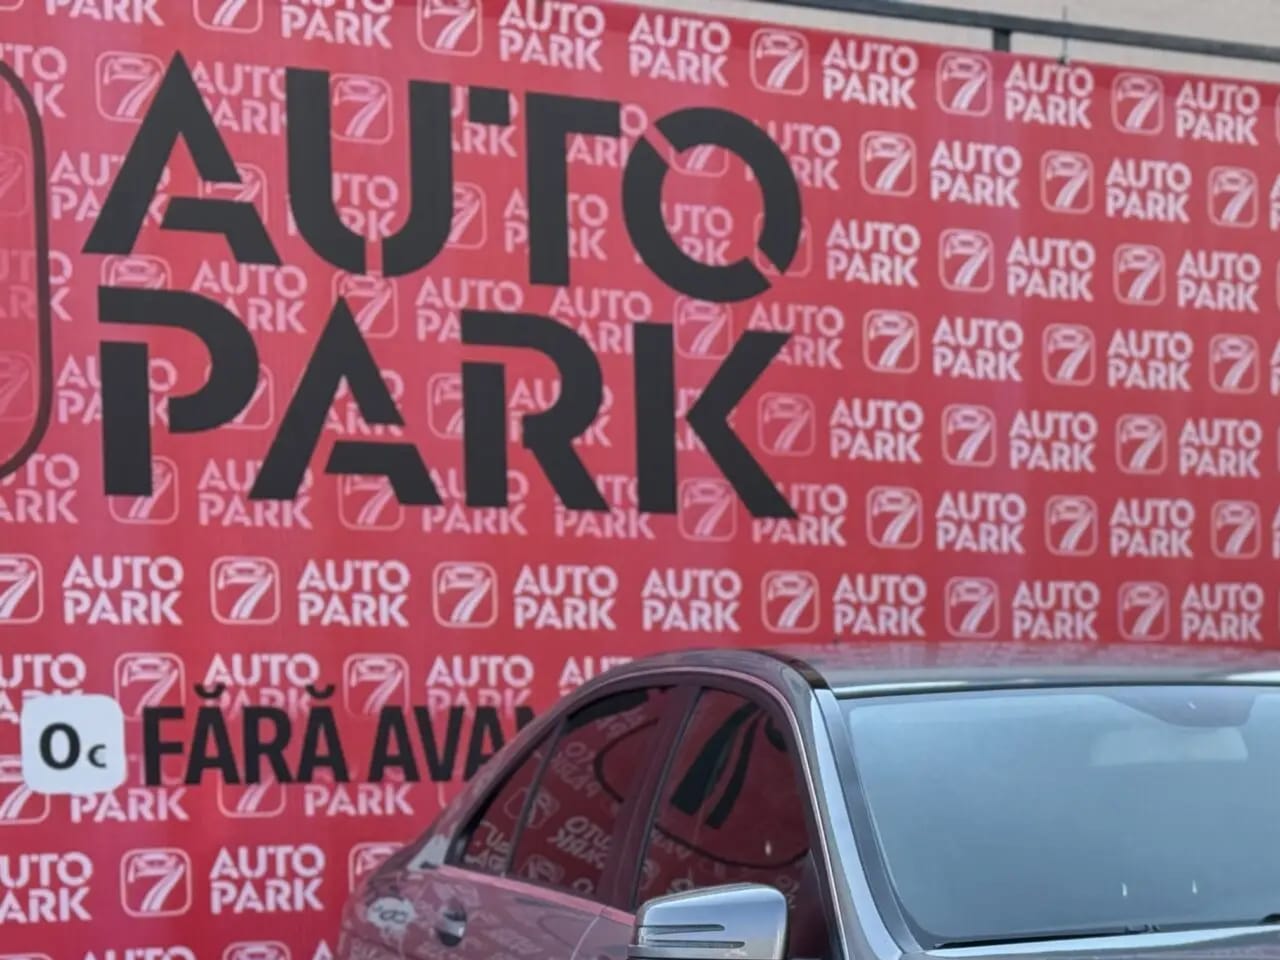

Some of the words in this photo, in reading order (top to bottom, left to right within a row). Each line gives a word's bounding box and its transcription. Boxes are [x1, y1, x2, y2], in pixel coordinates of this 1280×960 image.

[281, 4, 392, 49] PARK
[499, 0, 605, 39] AUTO
[629, 13, 731, 52] AUTO
[499, 30, 603, 72] PARK
[629, 44, 729, 88] PARK
[823, 39, 919, 77] AUTO
[823, 68, 917, 110] PARK
[1005, 62, 1094, 97] AUTO
[1004, 90, 1092, 128] PARK
[1175, 81, 1261, 116] AUTO
[1176, 105, 1259, 146] PARK
[929, 141, 1023, 177] AUTO
[82, 50, 803, 303] AUTO
[930, 168, 1022, 208] PARK
[1105, 160, 1192, 193] AUTO
[1105, 188, 1191, 222] PARK
[827, 220, 921, 255] AUTO
[827, 249, 920, 286] PARK
[1007, 238, 1096, 272] AUTO
[1177, 251, 1261, 283] AUTO
[191, 260, 308, 298] AUTO
[415, 276, 525, 313] AUTO
[1006, 266, 1094, 299] PARK
[1177, 276, 1261, 310] PARK
[549, 286, 653, 322] AUTO
[747, 302, 844, 336] AUTO
[933, 318, 1025, 351] AUTO
[1108, 331, 1194, 360] AUTO
[932, 345, 1023, 380] PARK
[1107, 359, 1192, 389] PARK
[97, 285, 799, 519] PARK
[831, 400, 924, 432] AUTO
[1008, 411, 1099, 442] AUTO
[1178, 419, 1263, 447] AUTO
[831, 428, 923, 462] PARK
[1009, 439, 1096, 470] PARK
[1178, 446, 1261, 476] PARK
[199, 493, 312, 530] PARK
[936, 492, 1028, 522] AUTO
[1110, 499, 1196, 529] AUTO
[936, 521, 1026, 552] PARK
[1109, 528, 1194, 556] PARK
[63, 556, 183, 591] AUTO
[298, 560, 410, 593] AUTO
[514, 566, 618, 598] AUTO
[640, 568, 742, 601] AUTO
[833, 574, 927, 606] AUTO
[63, 588, 181, 624] PARK
[298, 593, 410, 626] PARK
[514, 596, 618, 629] PARK
[1012, 581, 1100, 610] AUTO
[1181, 583, 1264, 613] AUTO
[642, 598, 741, 631] PARK
[833, 605, 926, 636] PARK
[1012, 610, 1100, 640] PARK
[1180, 611, 1263, 639] PARK
[203, 653, 320, 688] AUTO
[426, 655, 534, 689] AUTO
[142, 684, 350, 787] FĂRĂ
[304, 783, 414, 816] PARK
[210, 844, 327, 879] AUTO
[210, 878, 324, 914] PARK
